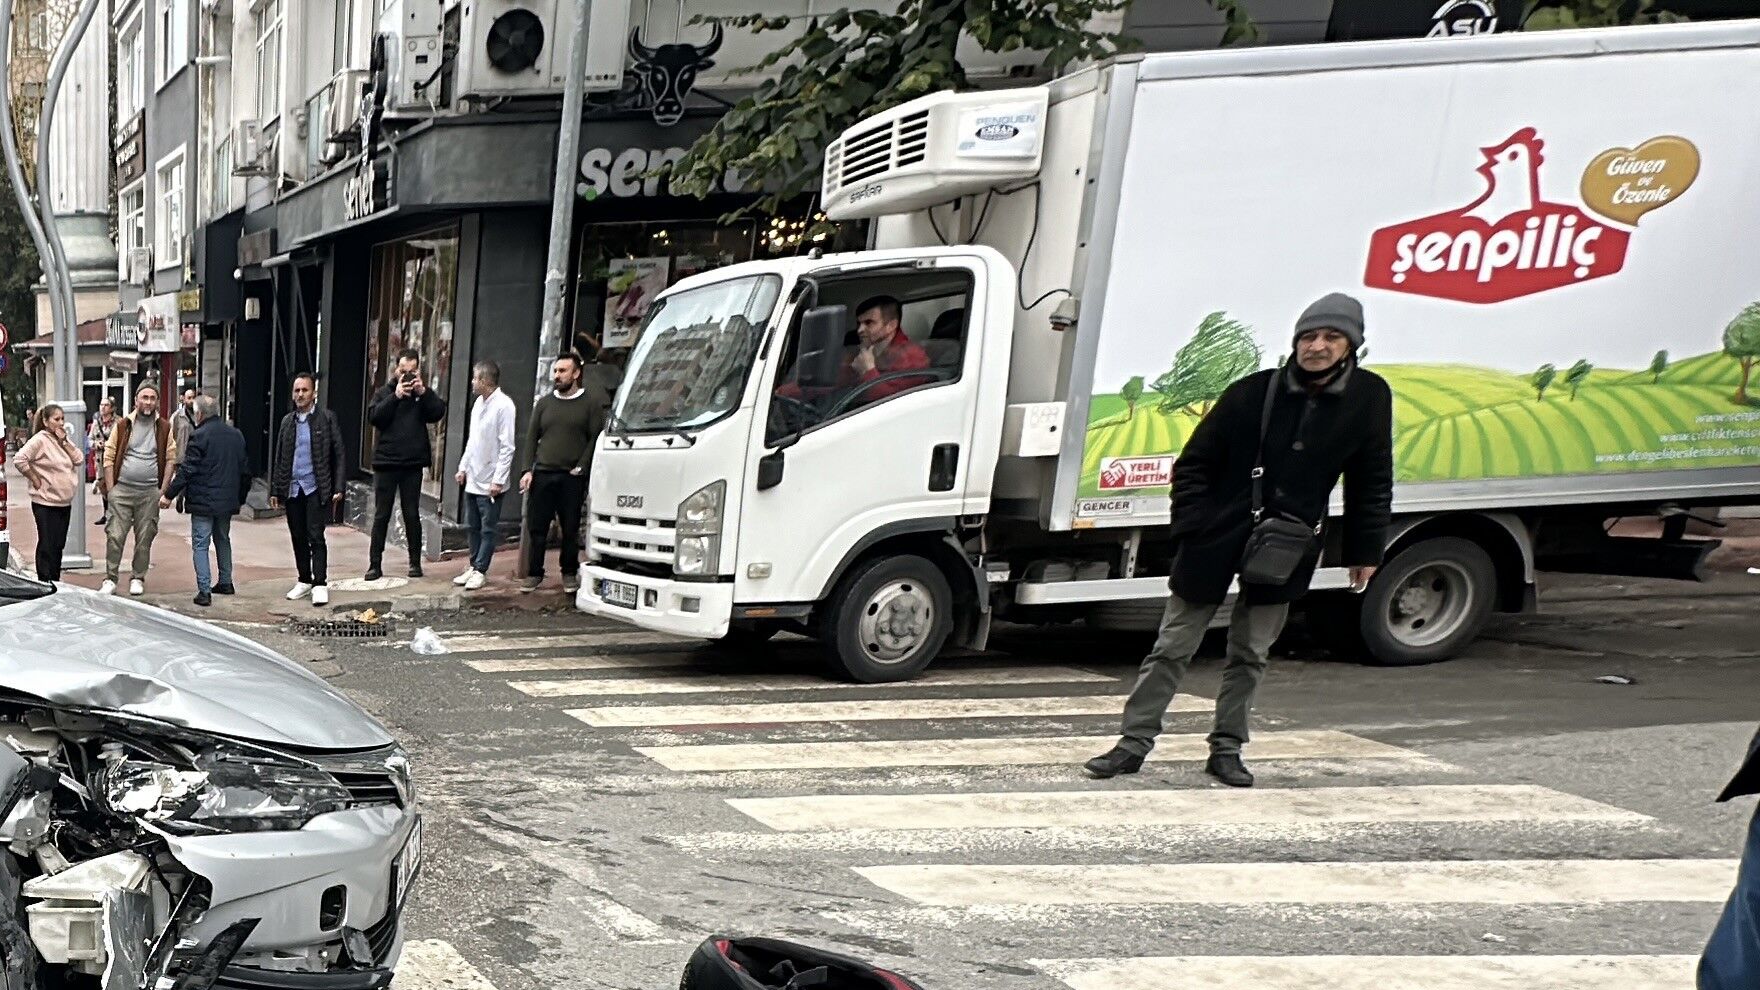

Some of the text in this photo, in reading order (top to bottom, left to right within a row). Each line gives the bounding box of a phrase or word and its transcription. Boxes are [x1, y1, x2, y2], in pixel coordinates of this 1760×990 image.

[1425, 17, 1498, 38] ASU
[1606, 155, 1666, 176] Güven
[1637, 175, 1653, 186] ve
[1612, 183, 1671, 204] Özenle
[1130, 460, 1161, 472] YERLİ
[1128, 473, 1168, 484] ÜRETİM
